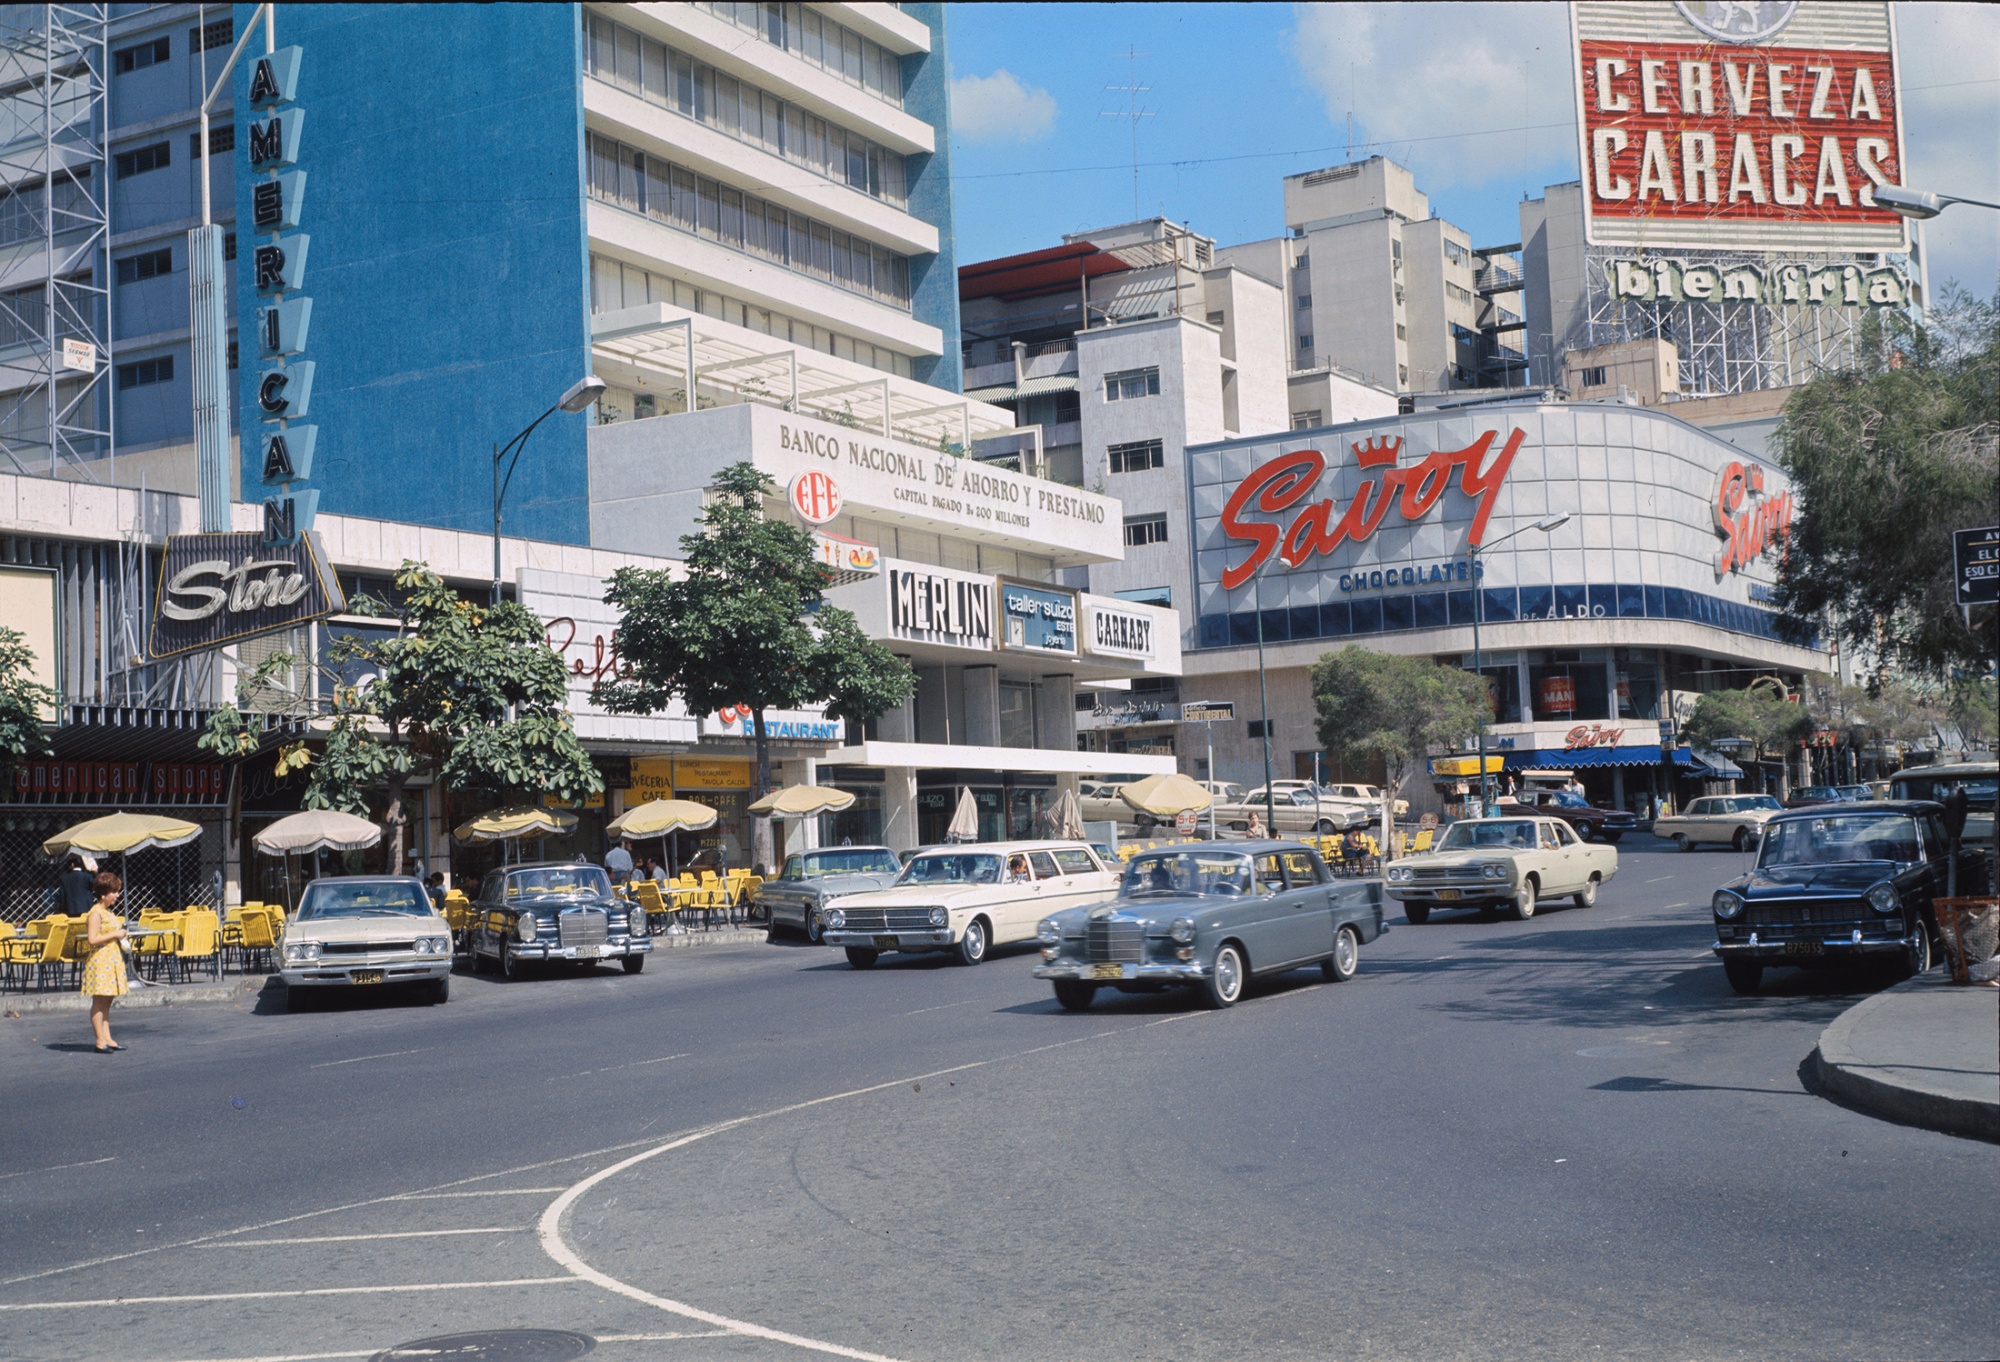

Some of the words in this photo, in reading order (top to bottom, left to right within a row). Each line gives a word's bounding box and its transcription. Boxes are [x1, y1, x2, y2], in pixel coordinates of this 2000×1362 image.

[1595, 57, 1882, 120] CERVEZA
[1593, 127, 1893, 207] CARACAS
[248, 56, 297, 547] AMERICAN
[1616, 260, 1760, 300] bien
[1781, 264, 1902, 304] fria
[780, 424, 840, 460] BANCO
[848, 441, 927, 481] NACIONAL
[934, 463, 954, 488] DE
[961, 470, 1019, 503] AHORRO
[1023, 486, 1031, 506] Y
[1038, 490, 1105, 524] PRESTAMO
[796, 472, 839, 519] EFE
[894, 487, 928, 506] CAPITAL
[932, 495, 962, 513] PAGADO
[976, 507, 992, 520] 200
[995, 510, 1030, 528] MILLONES
[1221, 426, 1527, 590] Savoy
[1979, 549, 1992, 560] EL
[161, 555, 310, 621] Store
[1339, 561, 1484, 592] CHOCOLATES
[889, 569, 992, 640] MERLIN
[1008, 593, 1041, 619] taller
[1043, 601, 1073, 621] suizo
[1547, 604, 1606, 619] ALDO
[1056, 620, 1074, 633] ESTE
[1096, 612, 1151, 651] CARNABY
[743, 719, 839, 739] RSTAURANT
[1184, 709, 1233, 721] CONTINENTAL
[1566, 726, 1624, 749] Savoy
[19, 764, 138, 788] american
[641, 790, 667, 801] CAFE
